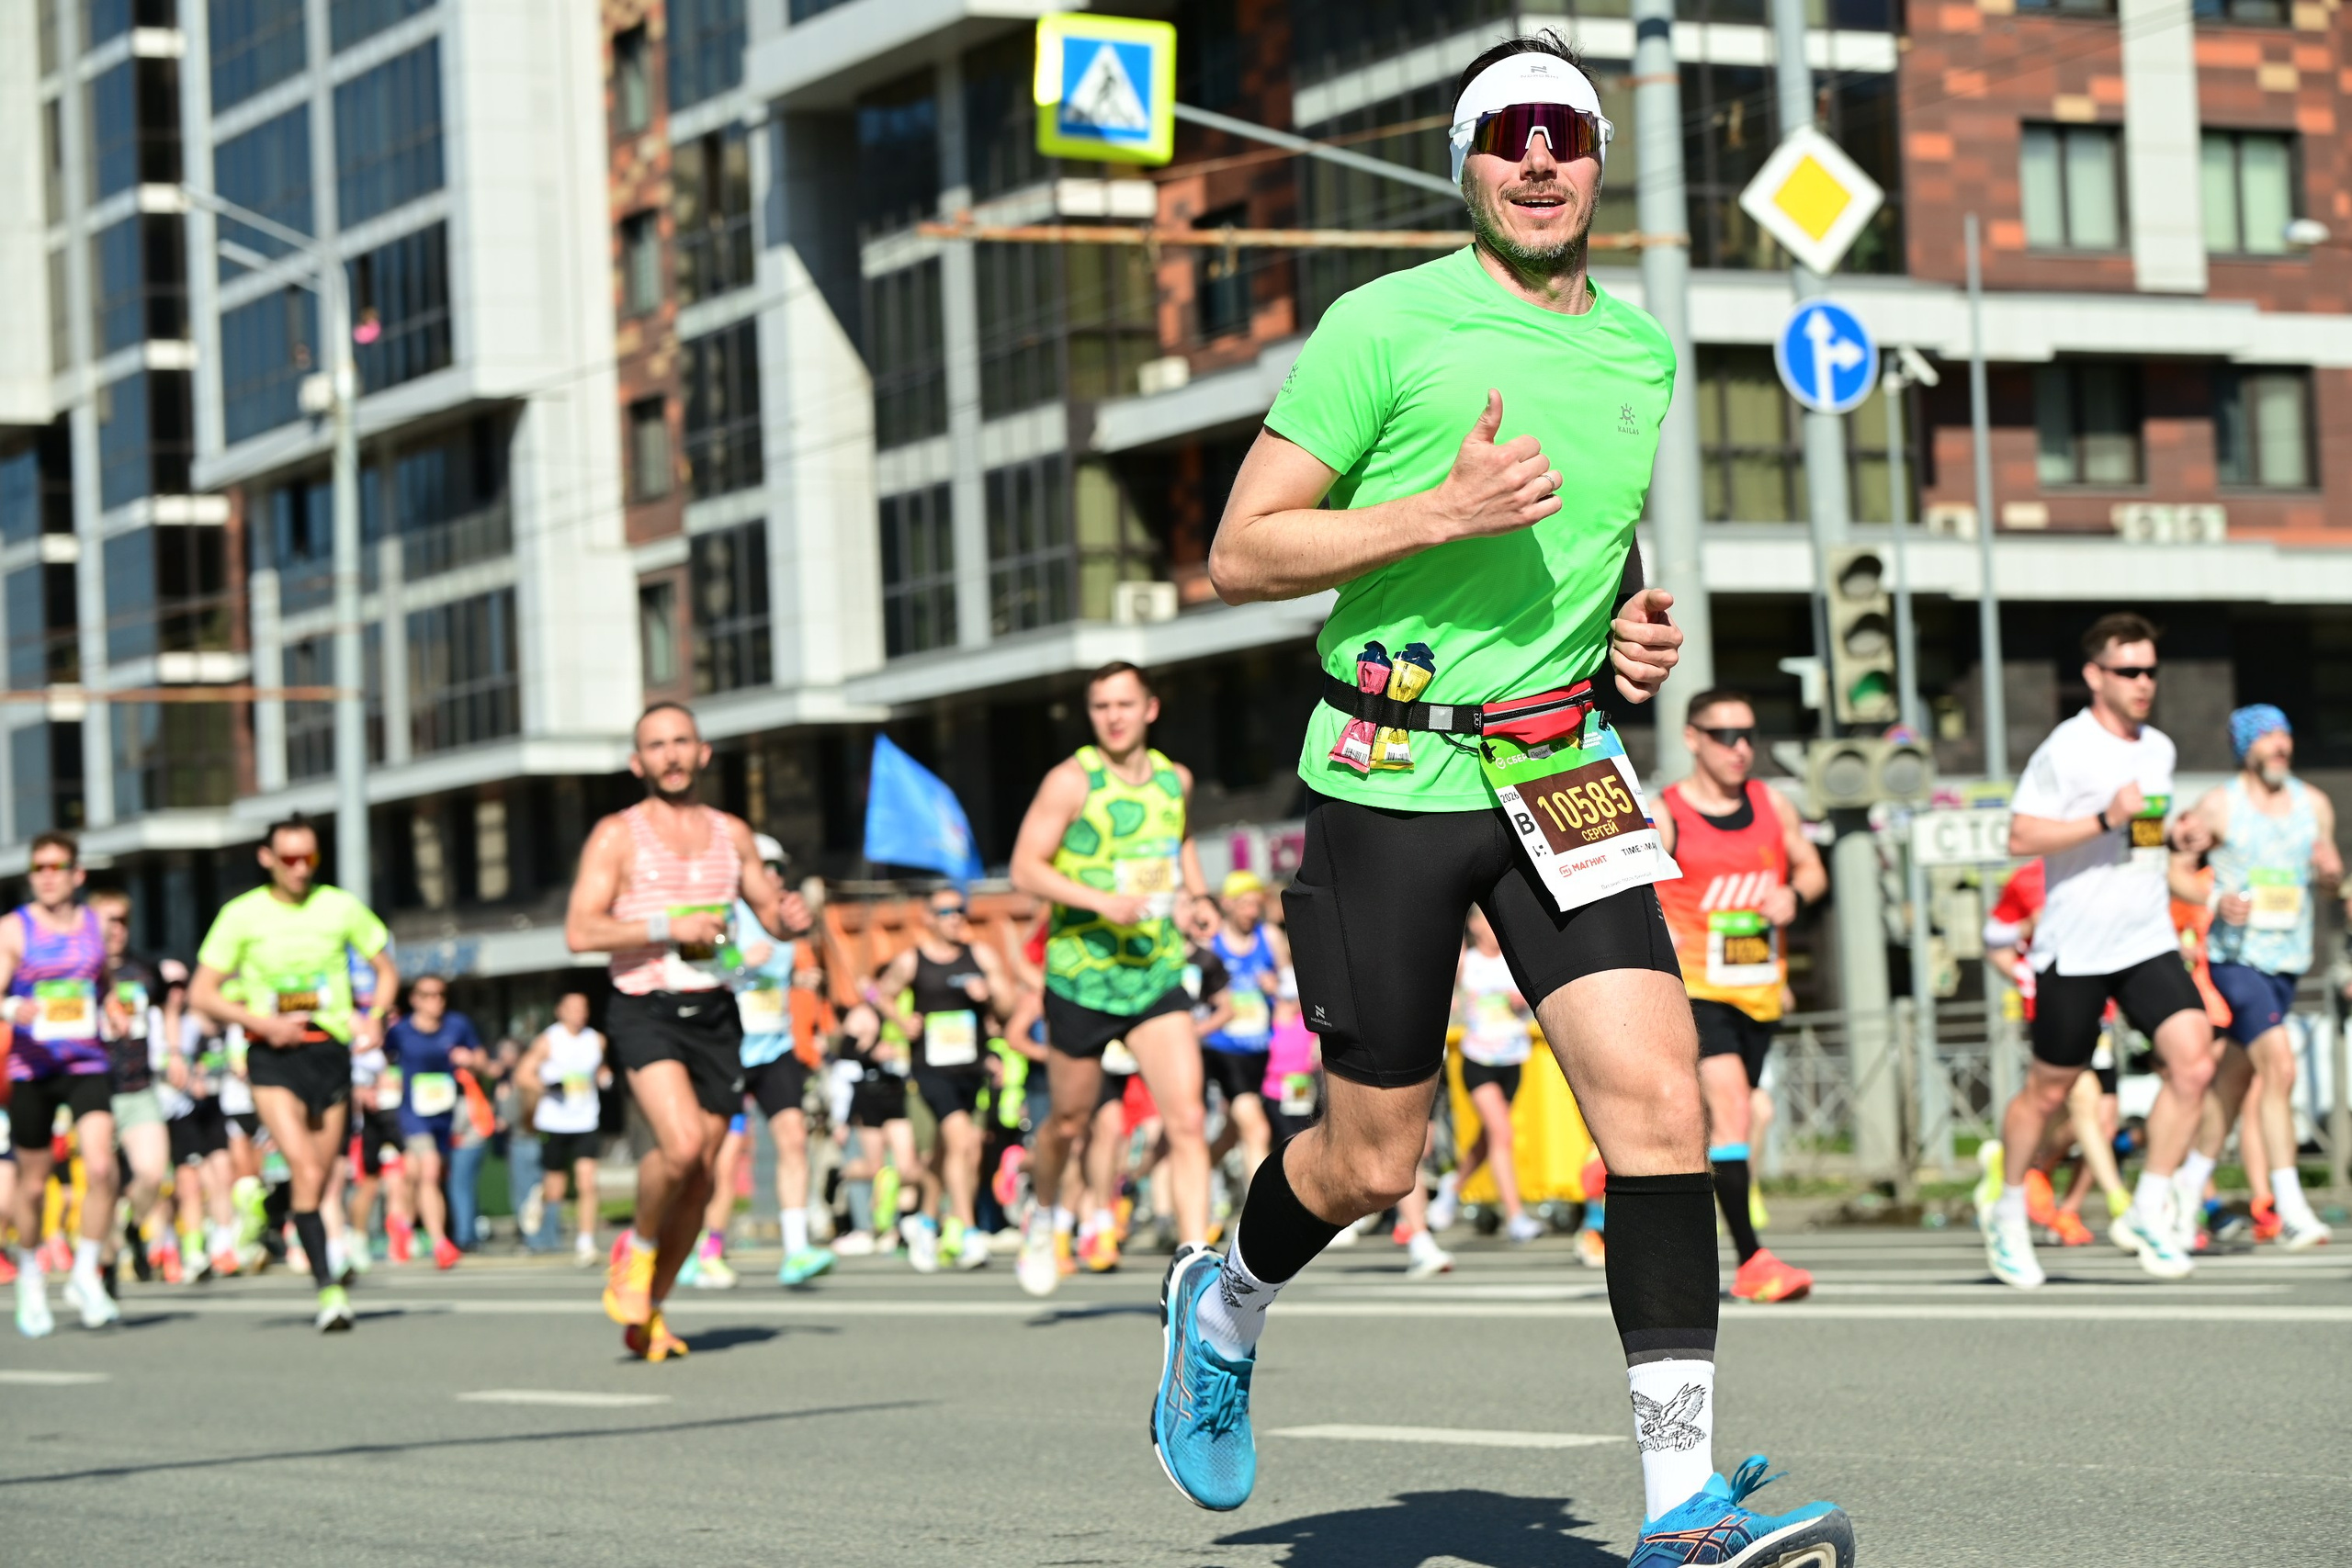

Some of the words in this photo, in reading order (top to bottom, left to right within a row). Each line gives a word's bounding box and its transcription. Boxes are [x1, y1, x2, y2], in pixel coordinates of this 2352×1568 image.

[1617, 425, 1640, 435] KAILAS
[1499, 791, 1520, 803] 2026
[1537, 774, 1633, 832] 10585
[1513, 812, 1535, 836] B
[1581, 818, 1620, 841] СЕРГЕЙ
[1934, 819, 2010, 854] СТО
[1572, 854, 1608, 872] МАГНИТ
